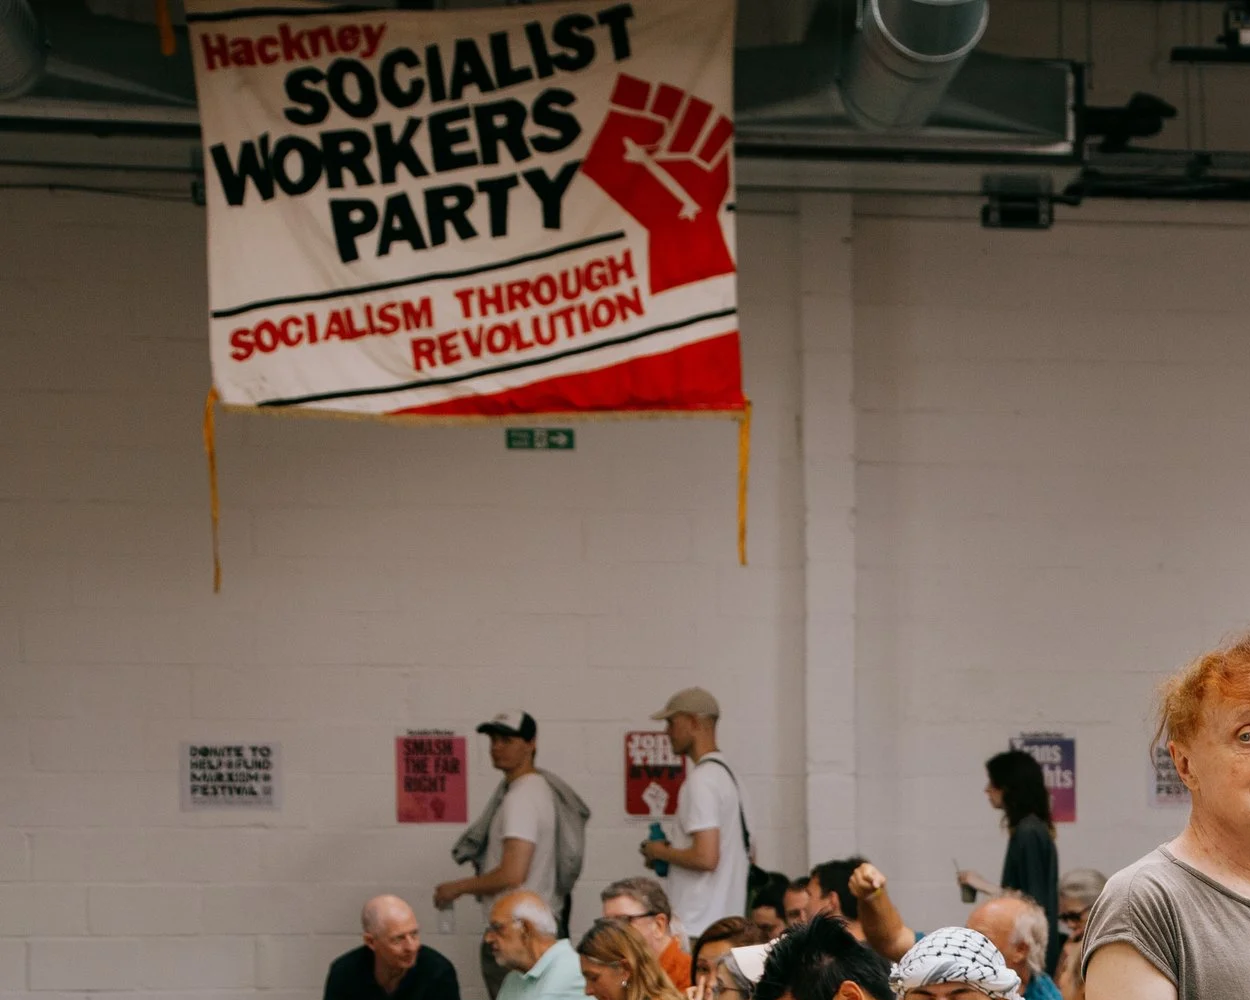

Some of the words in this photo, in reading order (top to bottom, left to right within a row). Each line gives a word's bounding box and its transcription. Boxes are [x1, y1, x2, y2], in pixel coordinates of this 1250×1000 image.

[201, 22, 387, 70] Hackney
[283, 4, 635, 126] SOCIALIST
[210, 87, 582, 206] WORKERS
[330, 160, 582, 264] PARTY
[229, 297, 434, 362] SOCIALISM
[453, 249, 637, 319] THROUGH
[410, 287, 645, 372] REVOLUTION
